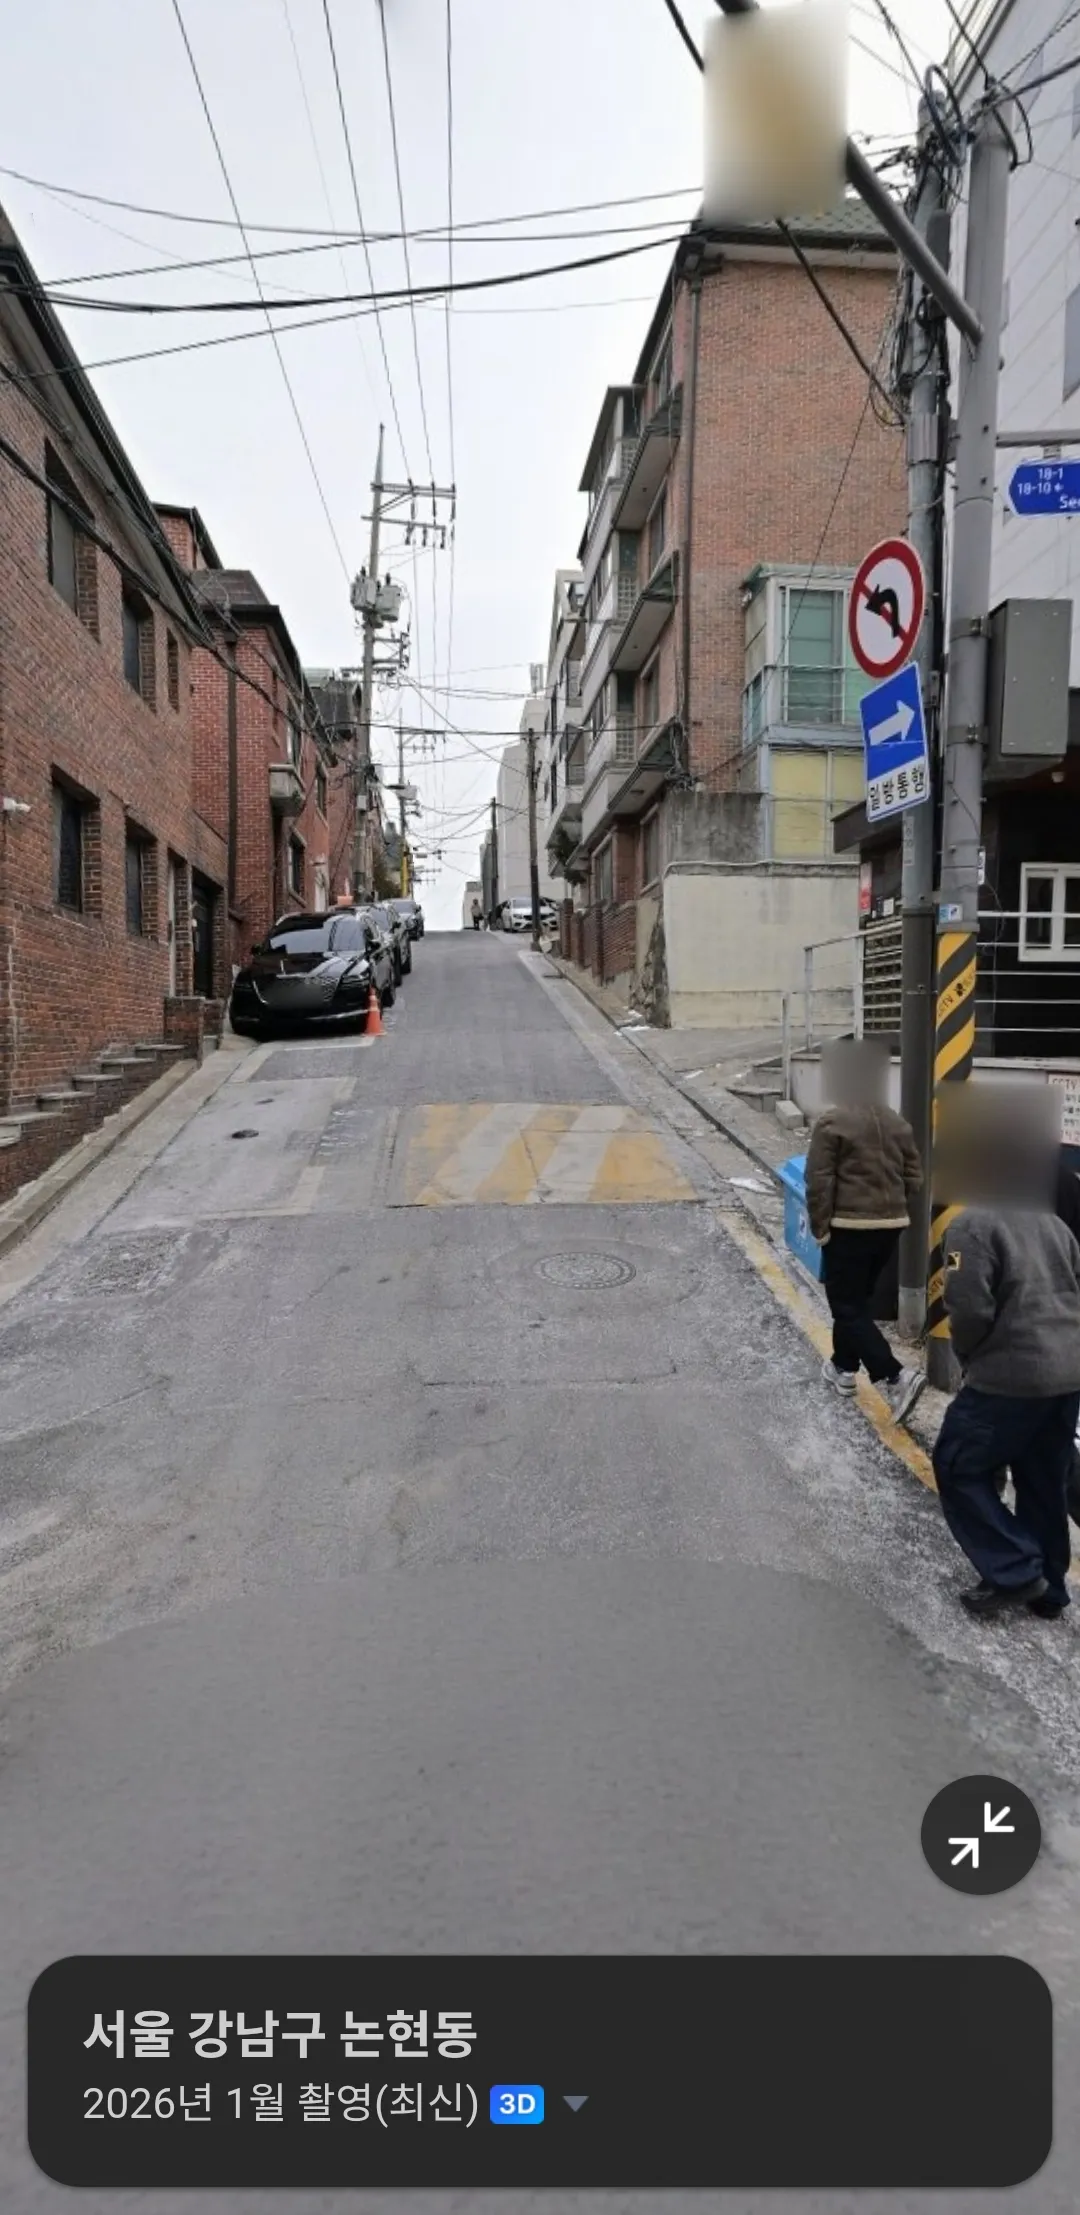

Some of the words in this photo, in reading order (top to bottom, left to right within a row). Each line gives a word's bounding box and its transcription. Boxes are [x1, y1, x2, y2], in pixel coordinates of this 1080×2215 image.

[1038, 467, 1063, 480] 18-1
[1017, 482, 1051, 495] 18-10
[870, 764, 924, 811] 일방통행
